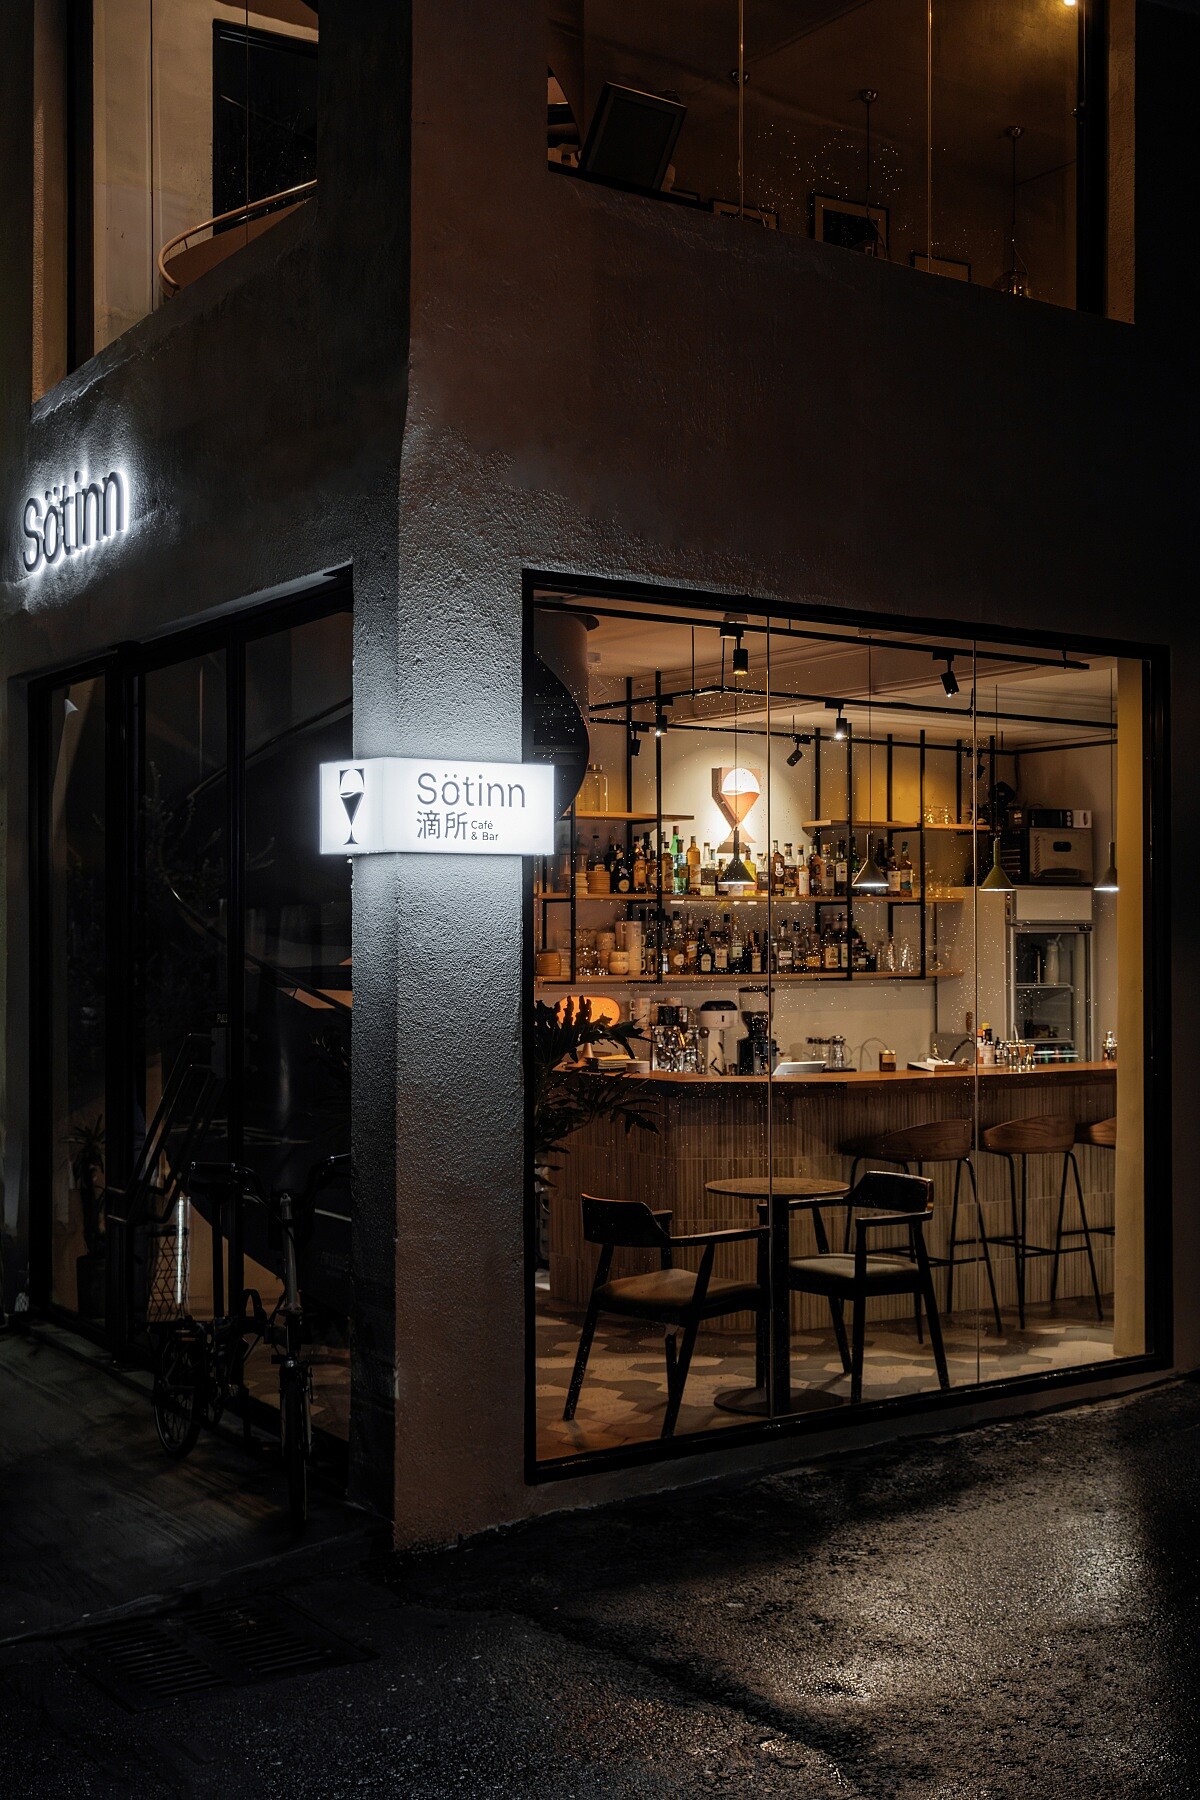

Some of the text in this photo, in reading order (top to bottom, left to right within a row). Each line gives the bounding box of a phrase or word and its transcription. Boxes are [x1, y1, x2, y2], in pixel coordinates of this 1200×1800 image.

[23, 471, 125, 573] Sötinn
[416, 772, 526, 808] Sötinn
[416, 810, 468, 840] 滴所
[470, 820, 494, 831] Café
[470, 832, 499, 841] & Bar
